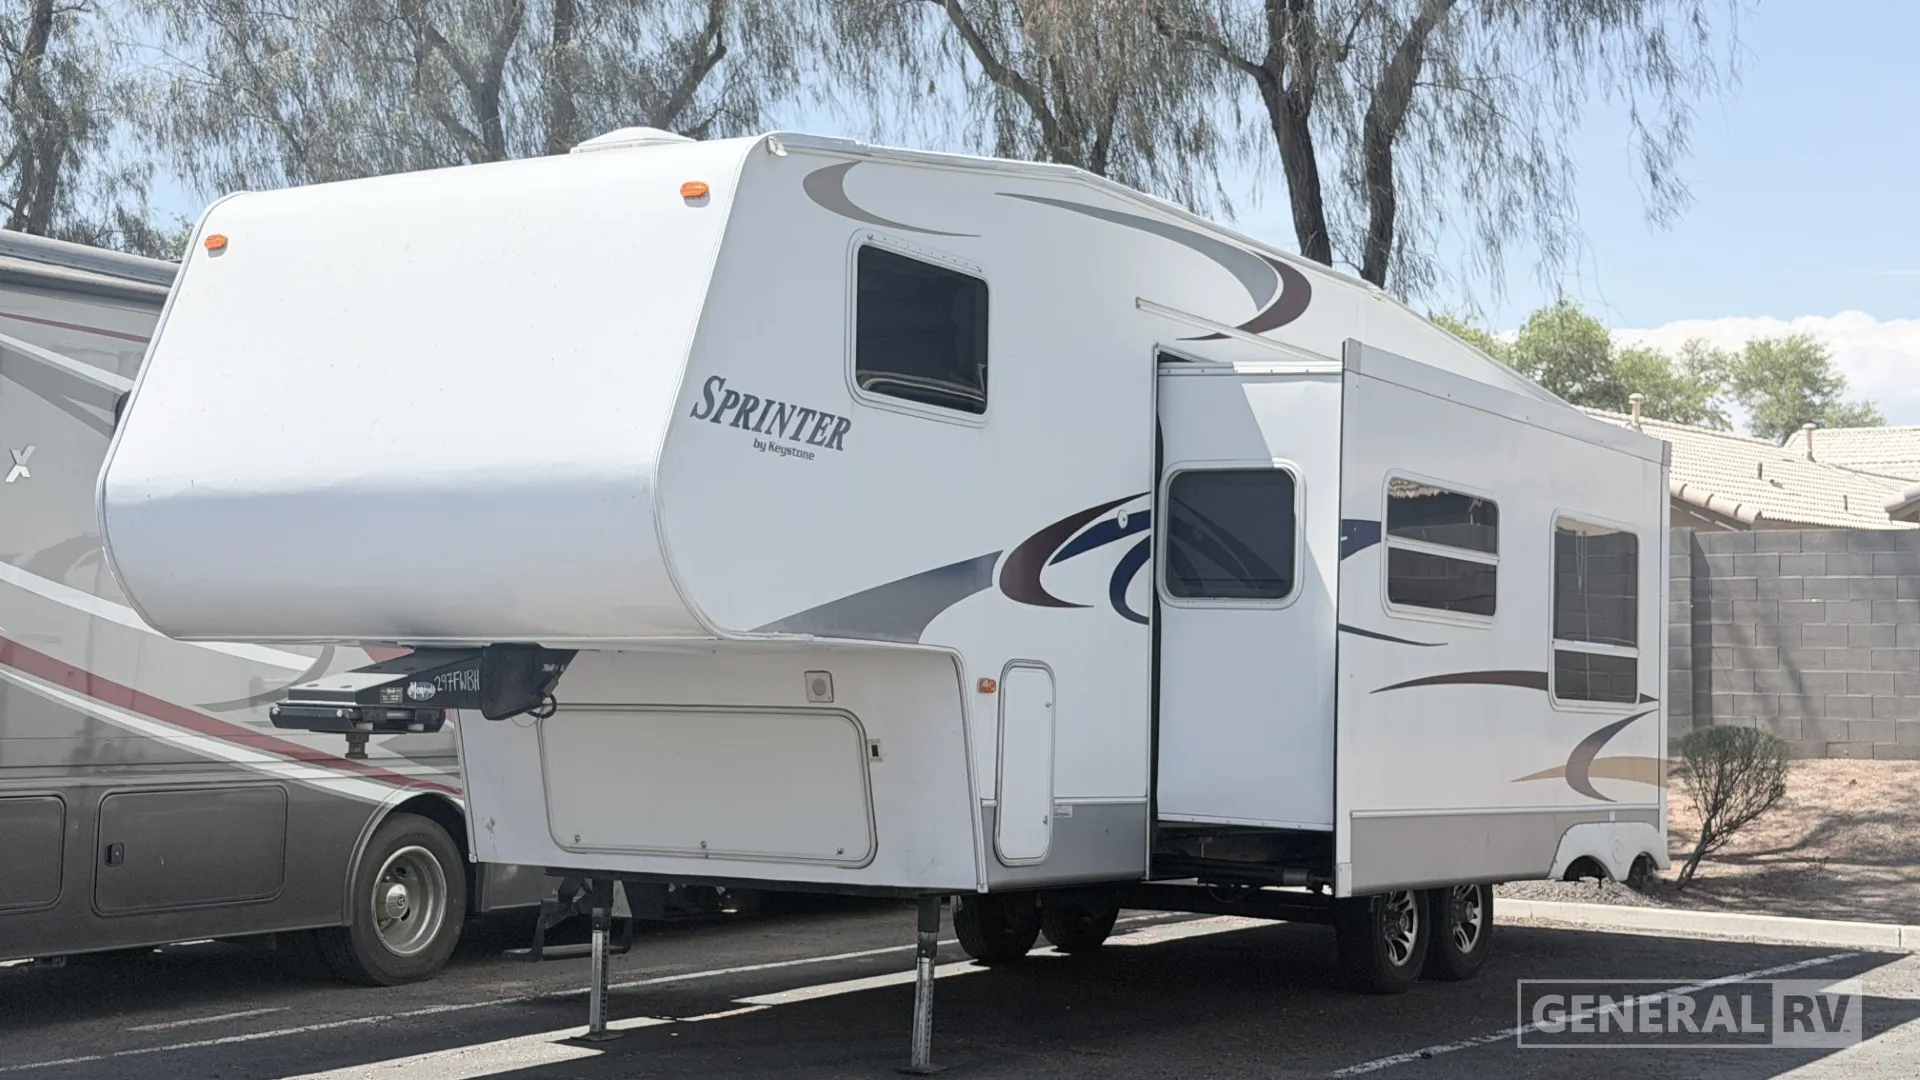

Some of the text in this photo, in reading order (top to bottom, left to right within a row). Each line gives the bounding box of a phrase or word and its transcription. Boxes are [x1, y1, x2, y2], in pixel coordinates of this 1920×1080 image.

[689, 375, 852, 451] SPRINTER
[753, 438, 815, 461] by Keystone
[433, 668, 480, 692] 297FWBH
